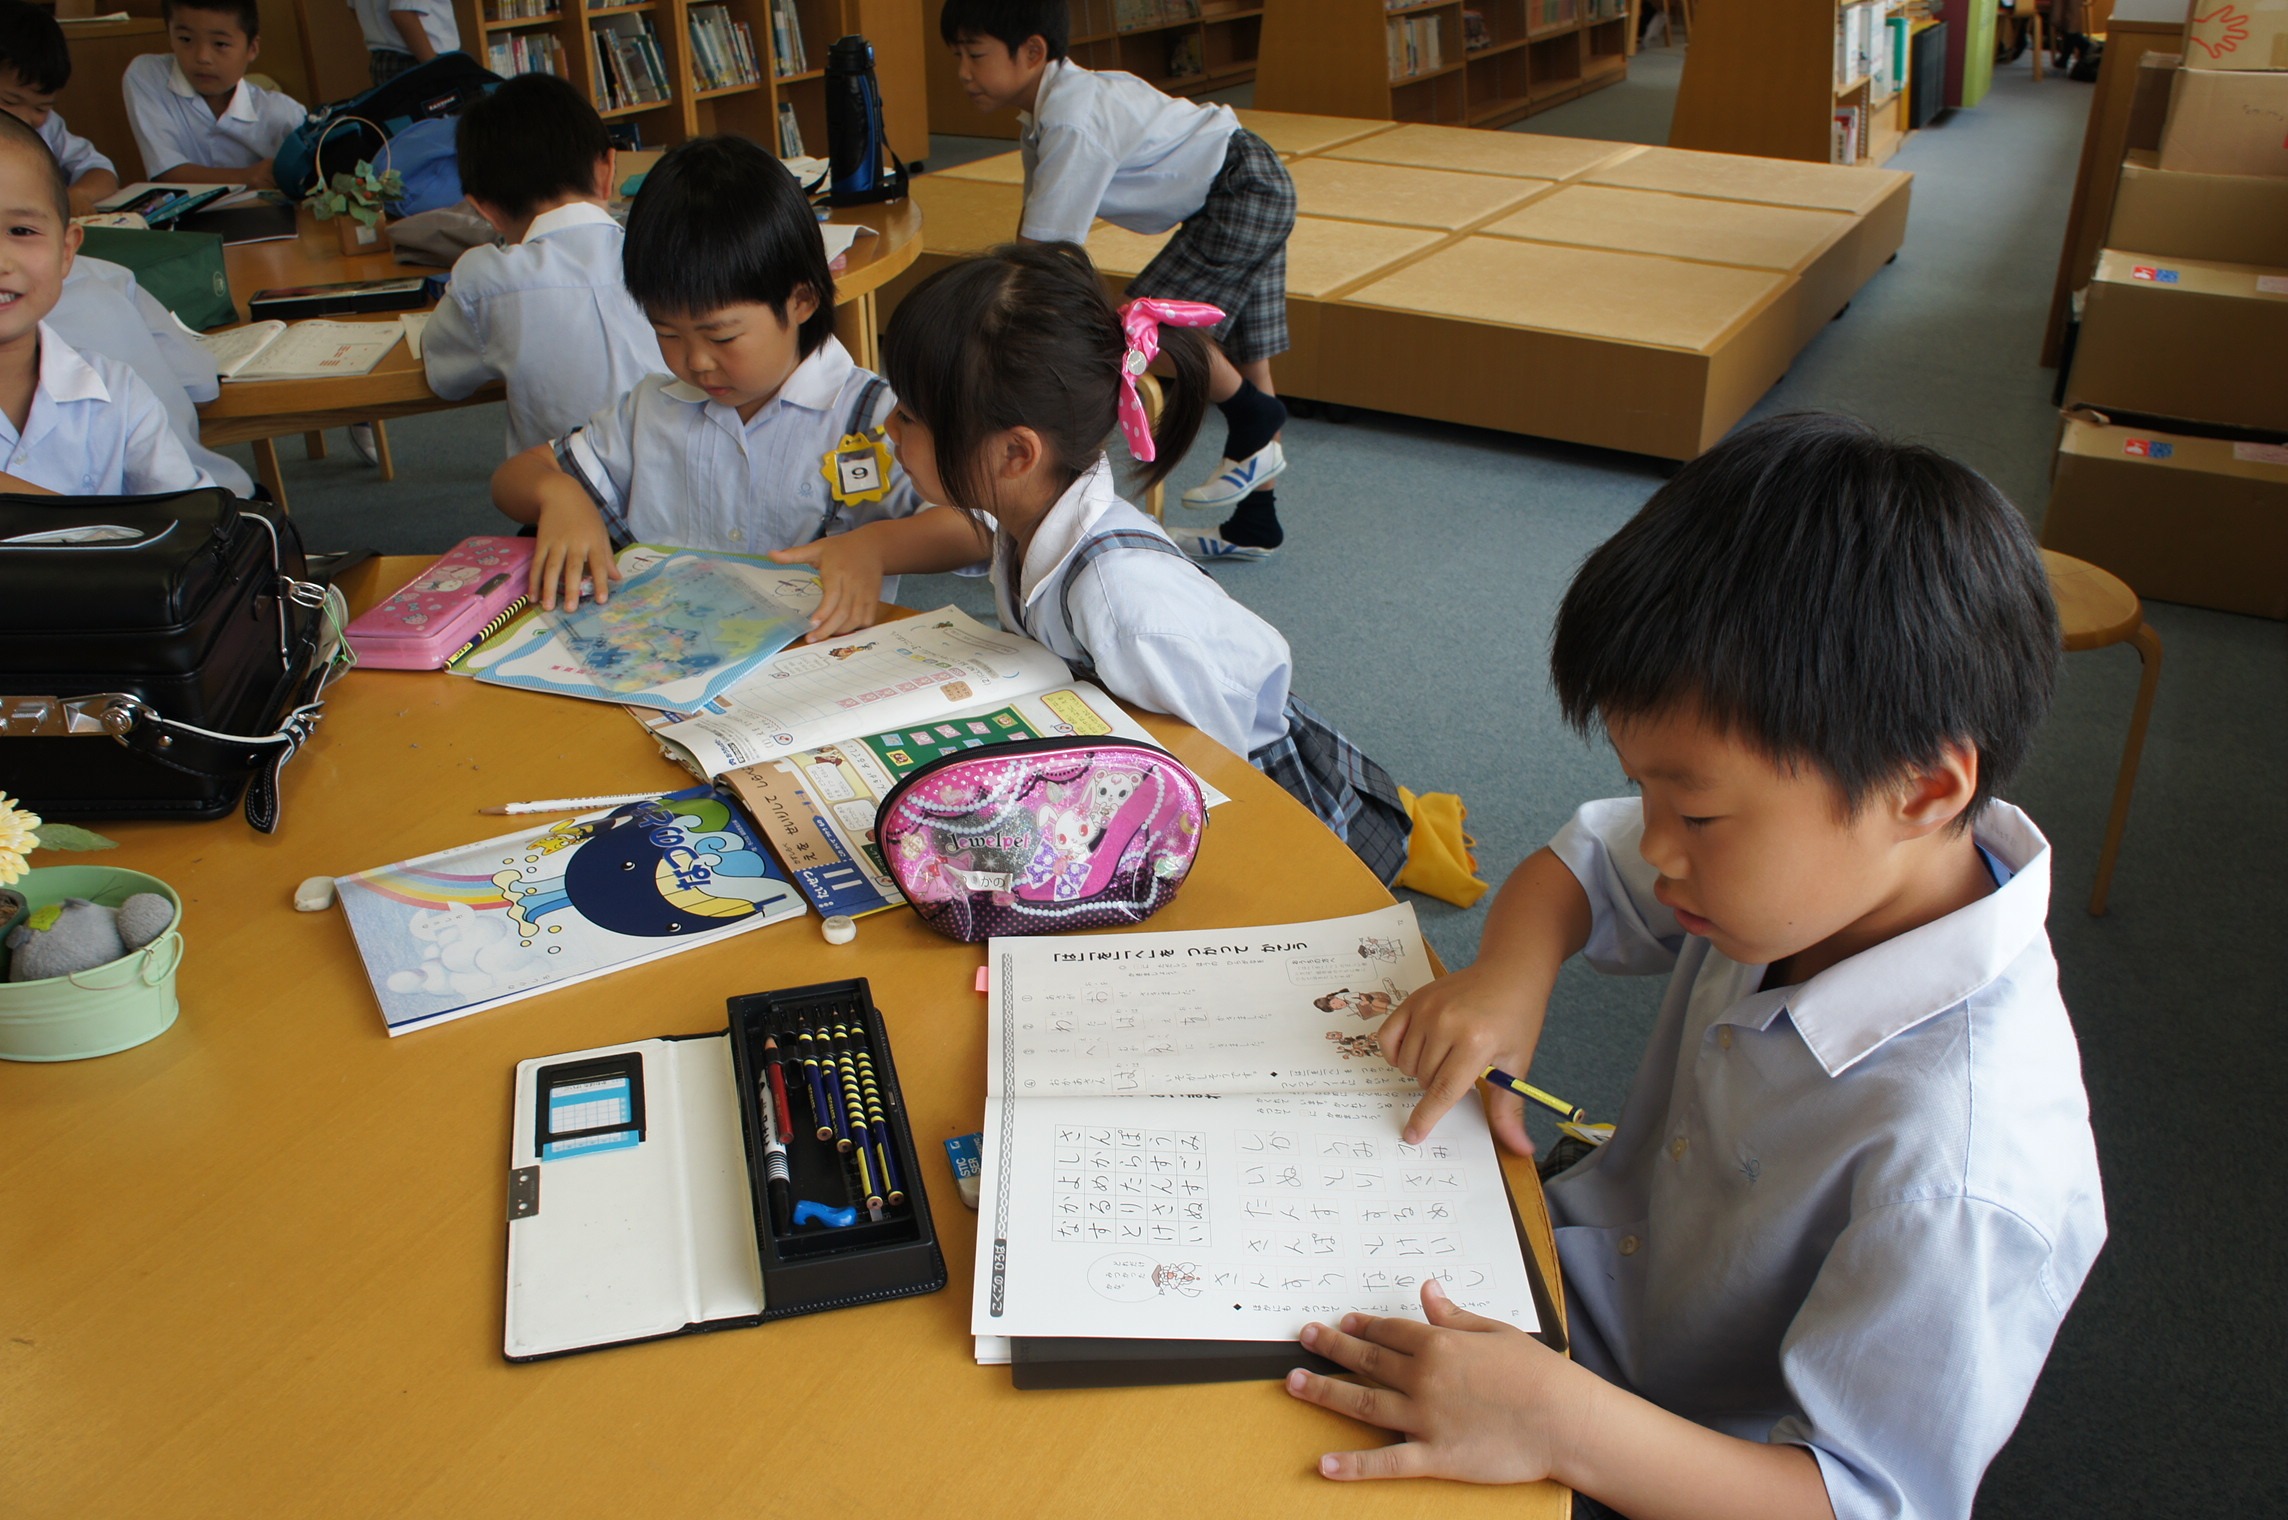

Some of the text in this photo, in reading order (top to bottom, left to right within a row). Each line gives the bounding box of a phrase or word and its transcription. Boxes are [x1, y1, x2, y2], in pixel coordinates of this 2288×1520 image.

[851, 466, 869, 480] 9
[764, 795, 798, 836] せいりして
[945, 830, 1030, 853] Jewelpet
[803, 870, 830, 899] たいせつ
[1188, 945, 1248, 957] つかって
[1261, 942, 1308, 953] かこう
[956, 1157, 972, 1177] STIC
[969, 1157, 981, 1174] SER
[991, 1245, 1006, 1311] こくごの ひろば
